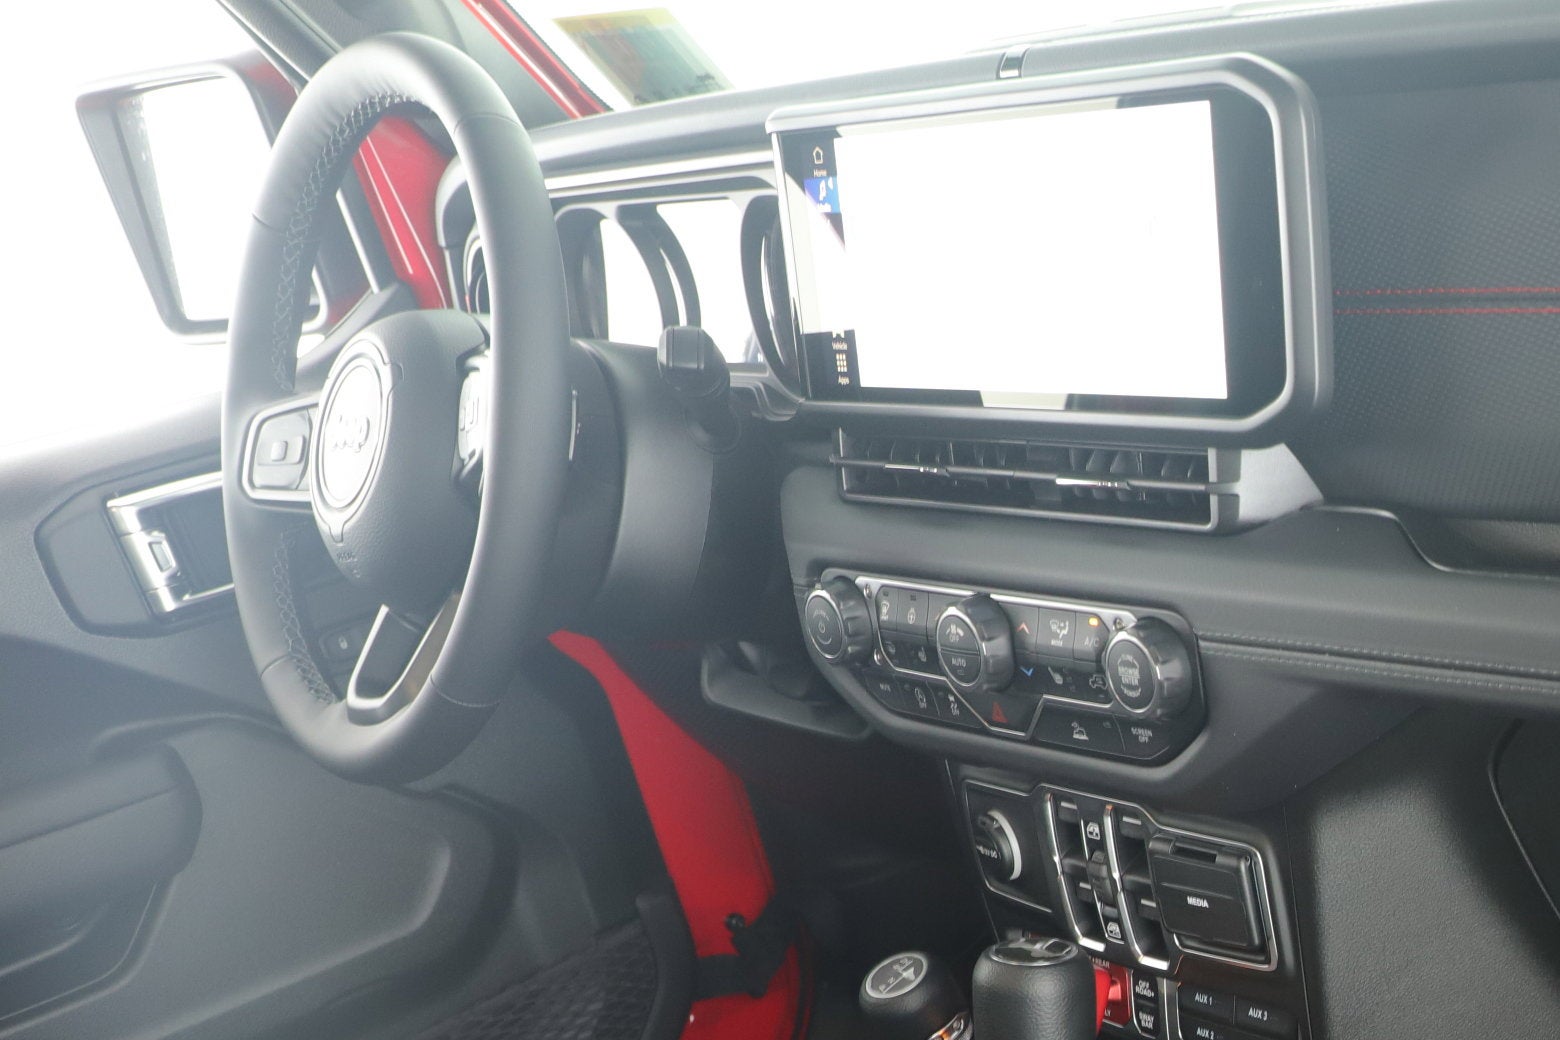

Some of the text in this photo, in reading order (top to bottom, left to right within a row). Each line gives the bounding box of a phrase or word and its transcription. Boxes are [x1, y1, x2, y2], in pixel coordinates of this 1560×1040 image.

[1084, 635, 1100, 648] A/C
[951, 656, 967, 668] AUTO
[1131, 727, 1153, 738] SCREEN
[1138, 735, 1149, 743] OFF
[1187, 896, 1209, 909] MEDIA
[1138, 979, 1150, 988] OFF
[1195, 992, 1208, 1005] AUX
[1248, 1007, 1264, 1019] AUX
[1141, 1018, 1153, 1030] BAR
[1196, 1027, 1210, 1039] AUX
